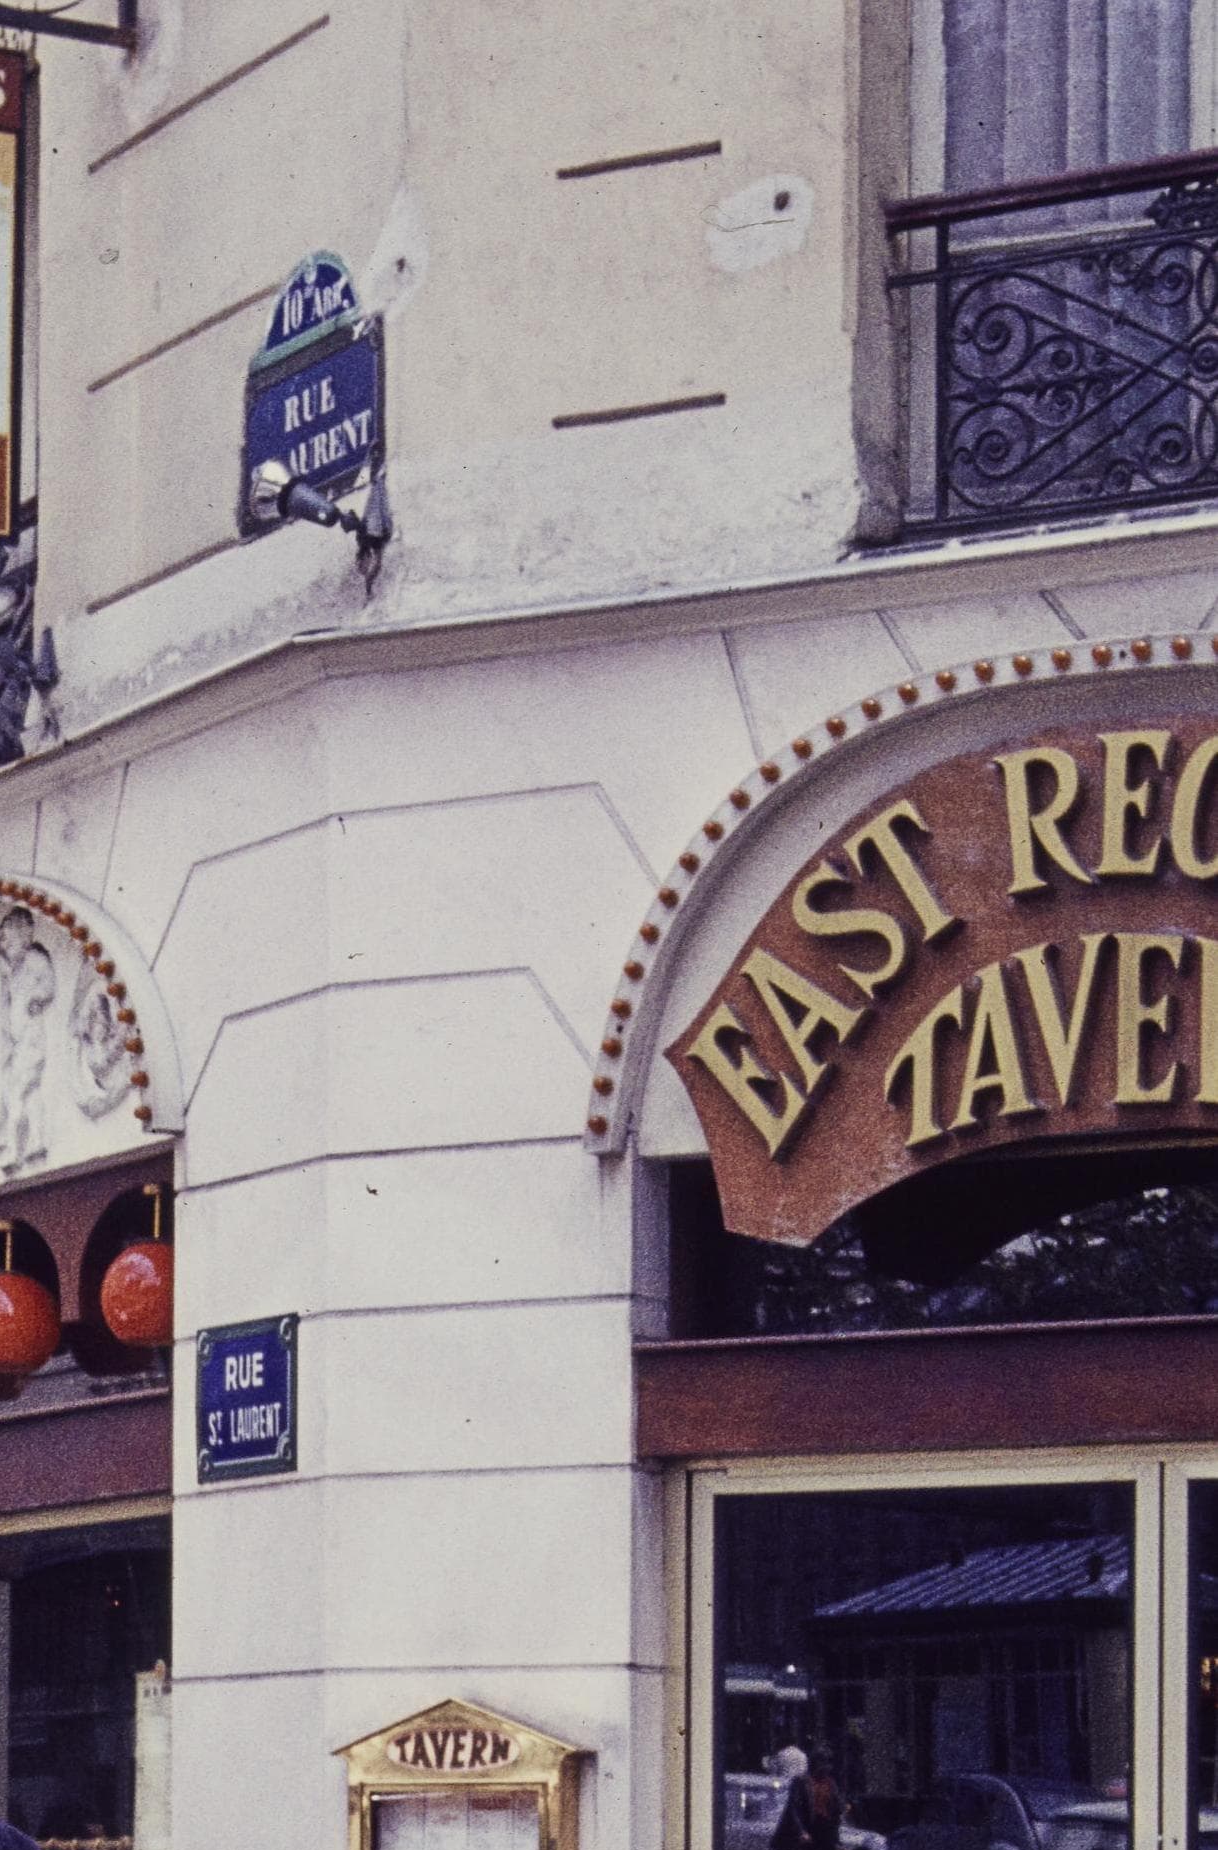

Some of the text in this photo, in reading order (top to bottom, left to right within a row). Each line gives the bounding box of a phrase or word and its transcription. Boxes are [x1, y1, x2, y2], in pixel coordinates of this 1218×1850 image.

[284, 375, 336, 433] RUE
[288, 408, 373, 478] AURENT
[686, 799, 957, 1161] EAST
[885, 933, 1218, 1149] TAVE
[224, 1352, 264, 1391] RUE
[230, 1402, 282, 1443] LAURENT
[392, 1728, 513, 1771] TAVERN
